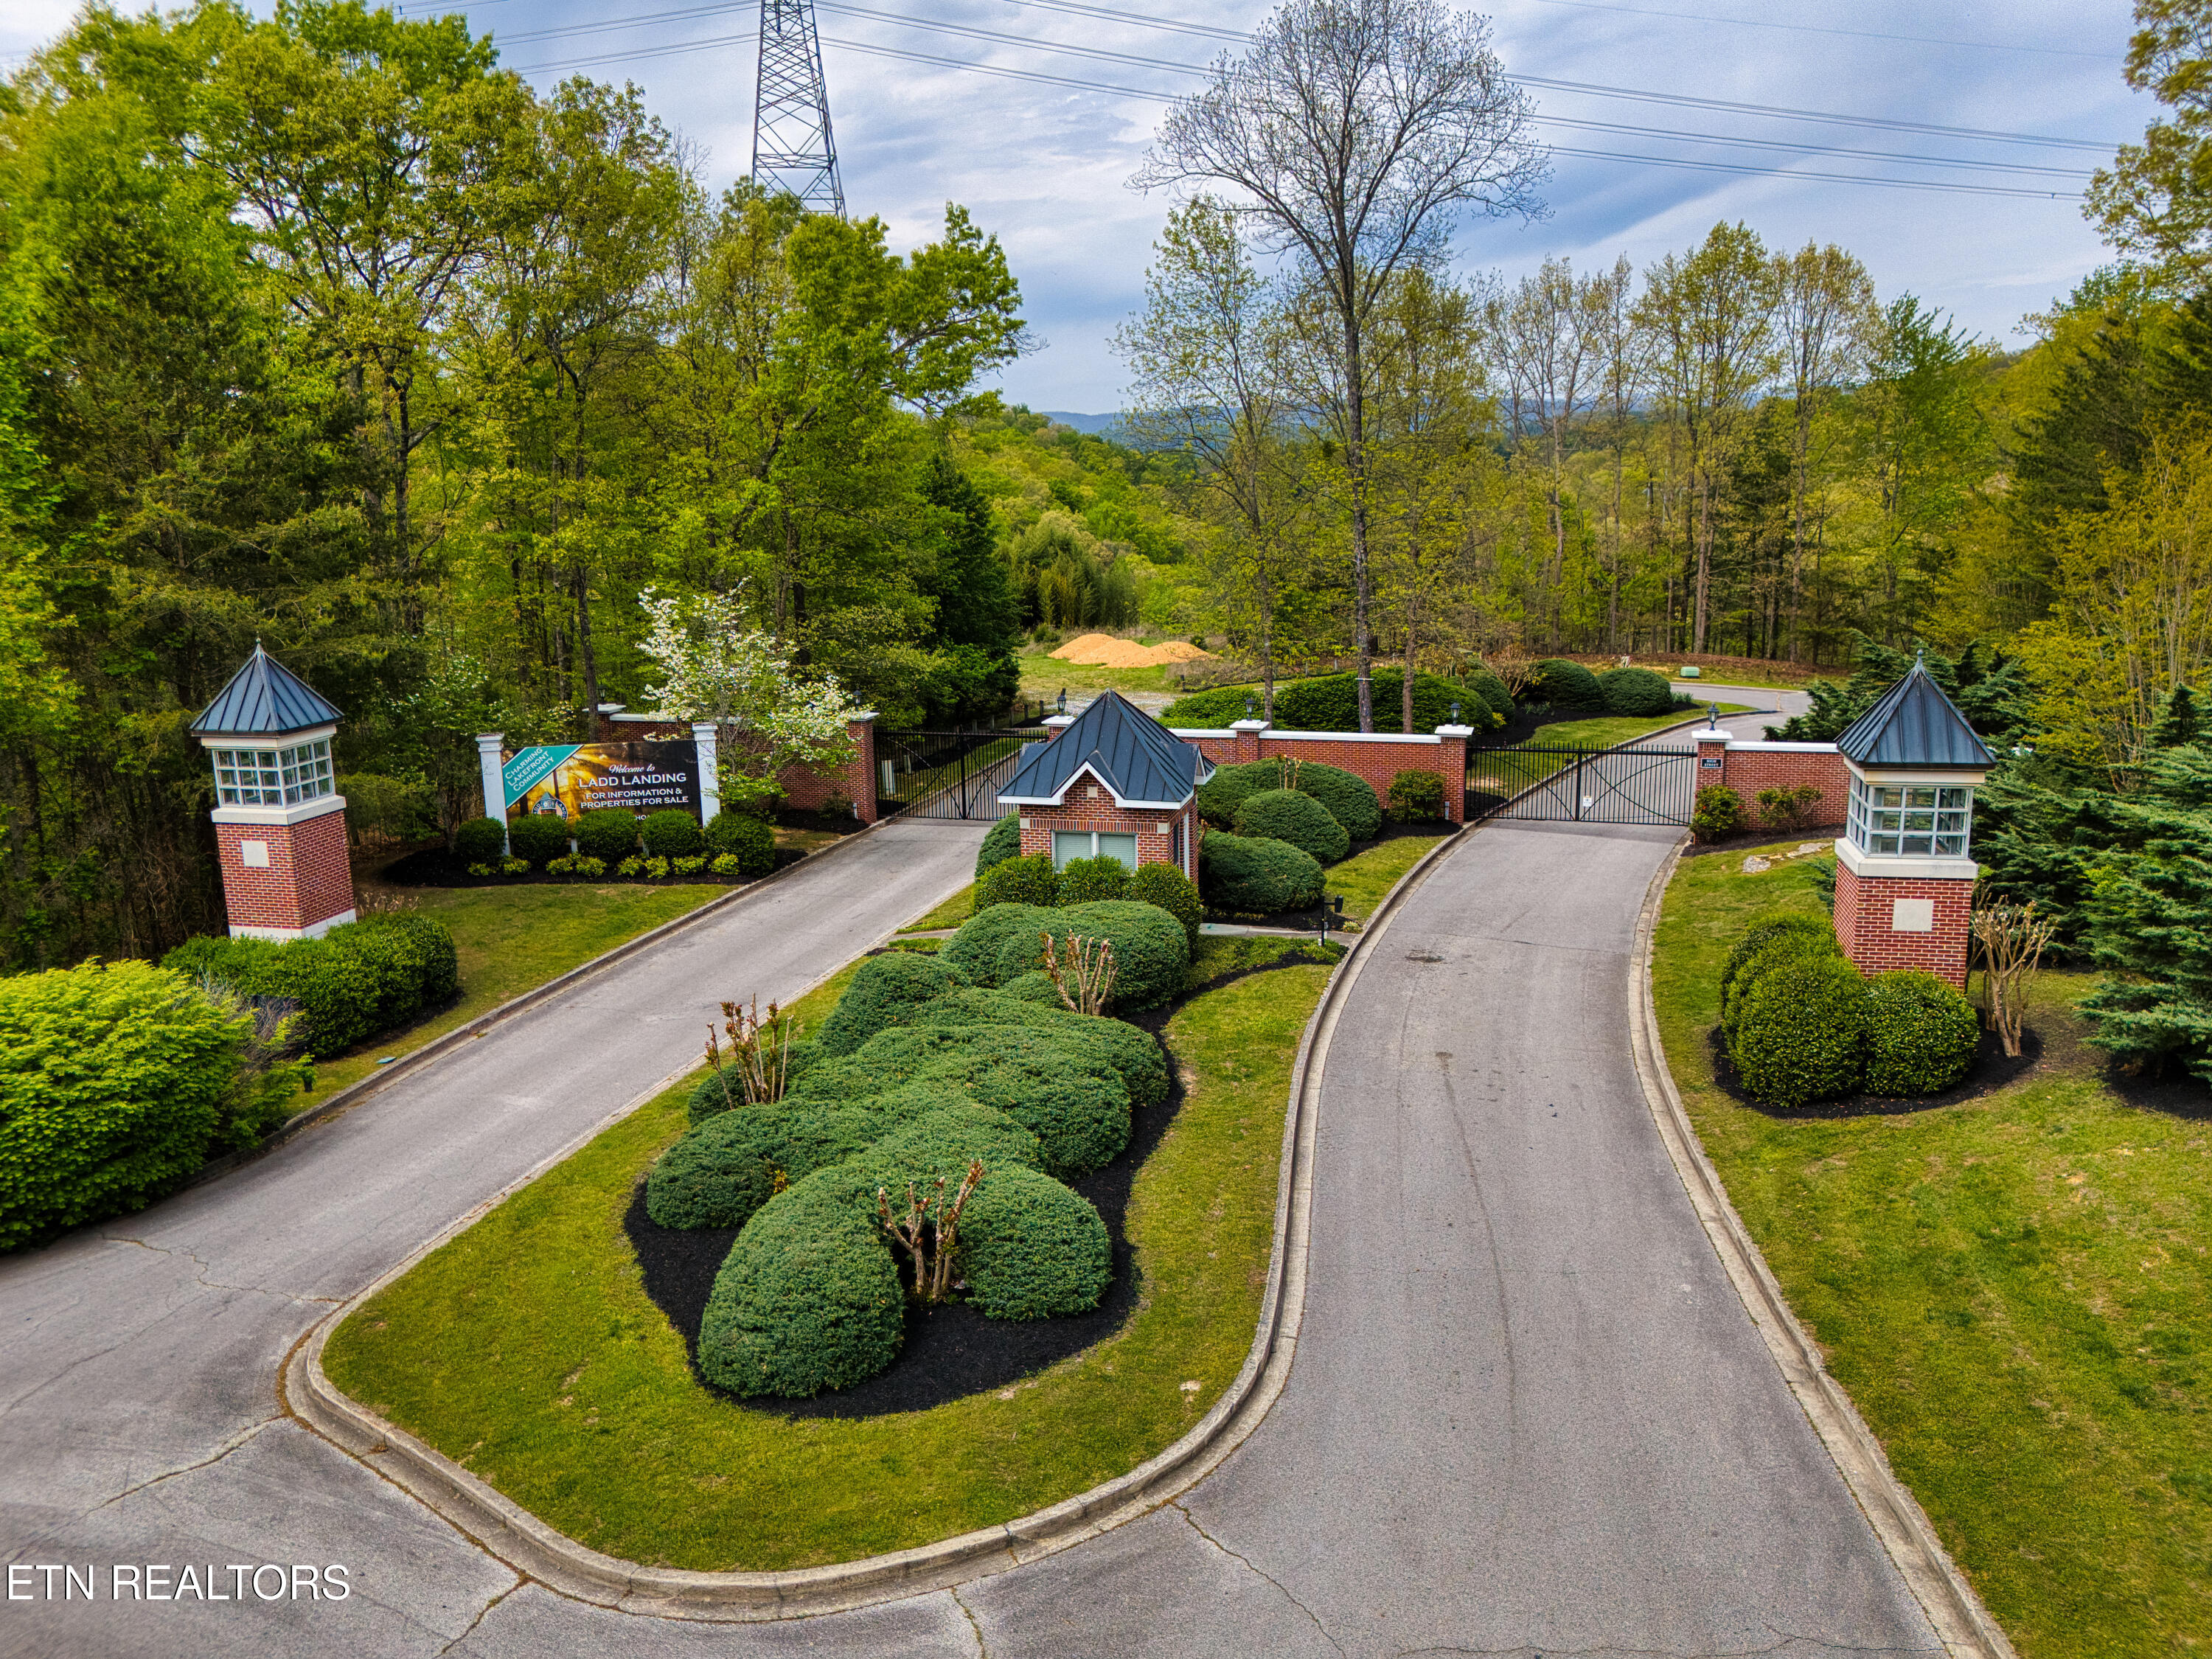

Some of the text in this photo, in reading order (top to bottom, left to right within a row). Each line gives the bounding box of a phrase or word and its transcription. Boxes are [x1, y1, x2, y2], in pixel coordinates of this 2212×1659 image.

[505, 748, 543, 779] CHARMING
[508, 751, 549, 786] LAKEFRONT
[609, 763, 655, 773] Welcome to
[513, 757, 554, 791] COMMUNITY
[578, 773, 686, 787] LADD LANDING
[585, 792, 605, 800] FOR
[608, 788, 673, 799] INFORMATION
[580, 796, 689, 808] PROPERTIES FOR SALE
